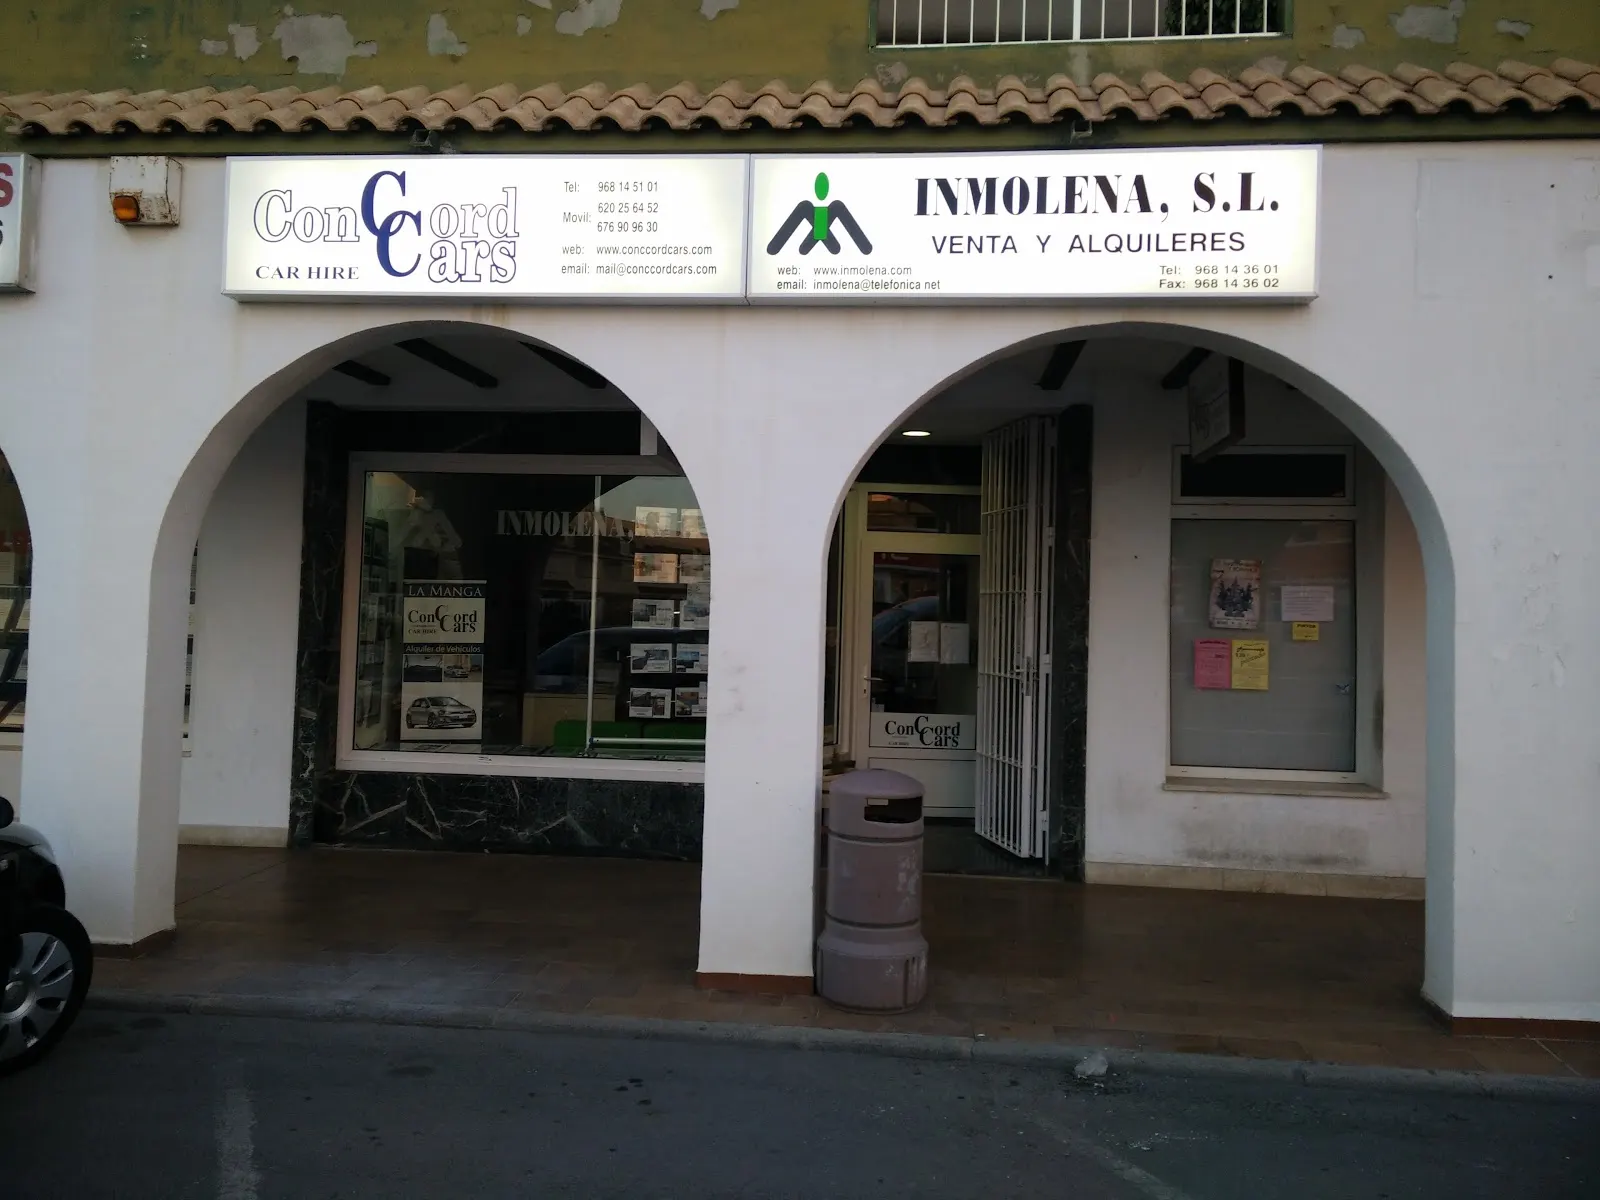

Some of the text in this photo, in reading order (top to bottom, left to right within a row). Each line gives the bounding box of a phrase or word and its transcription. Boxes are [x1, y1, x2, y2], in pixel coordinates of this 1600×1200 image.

[564, 181, 659, 193] Tel: 968 14 51 01
[914, 171, 1279, 222] INMOLENA, S.L.
[598, 202, 659, 214] 620 25 64 52
[563, 211, 592, 223] Movil:
[597, 221, 658, 233] 676 90 96 30
[932, 231, 1245, 254] VENTA Y ALQUILERES
[562, 243, 713, 255] web: www.conccordcars.com
[256, 266, 359, 280] CAR HIRE
[561, 262, 717, 276] email: mail@conccordcars.com
[777, 264, 912, 276] web: www.inmolena.com
[1159, 263, 1279, 275] Tel: 968 14 36 01
[776, 278, 808, 291] email:
[1159, 278, 1280, 290] Fax: 968 14 36 02
[409, 585, 482, 597] LA MANGA
[436, 644, 445, 653] de
